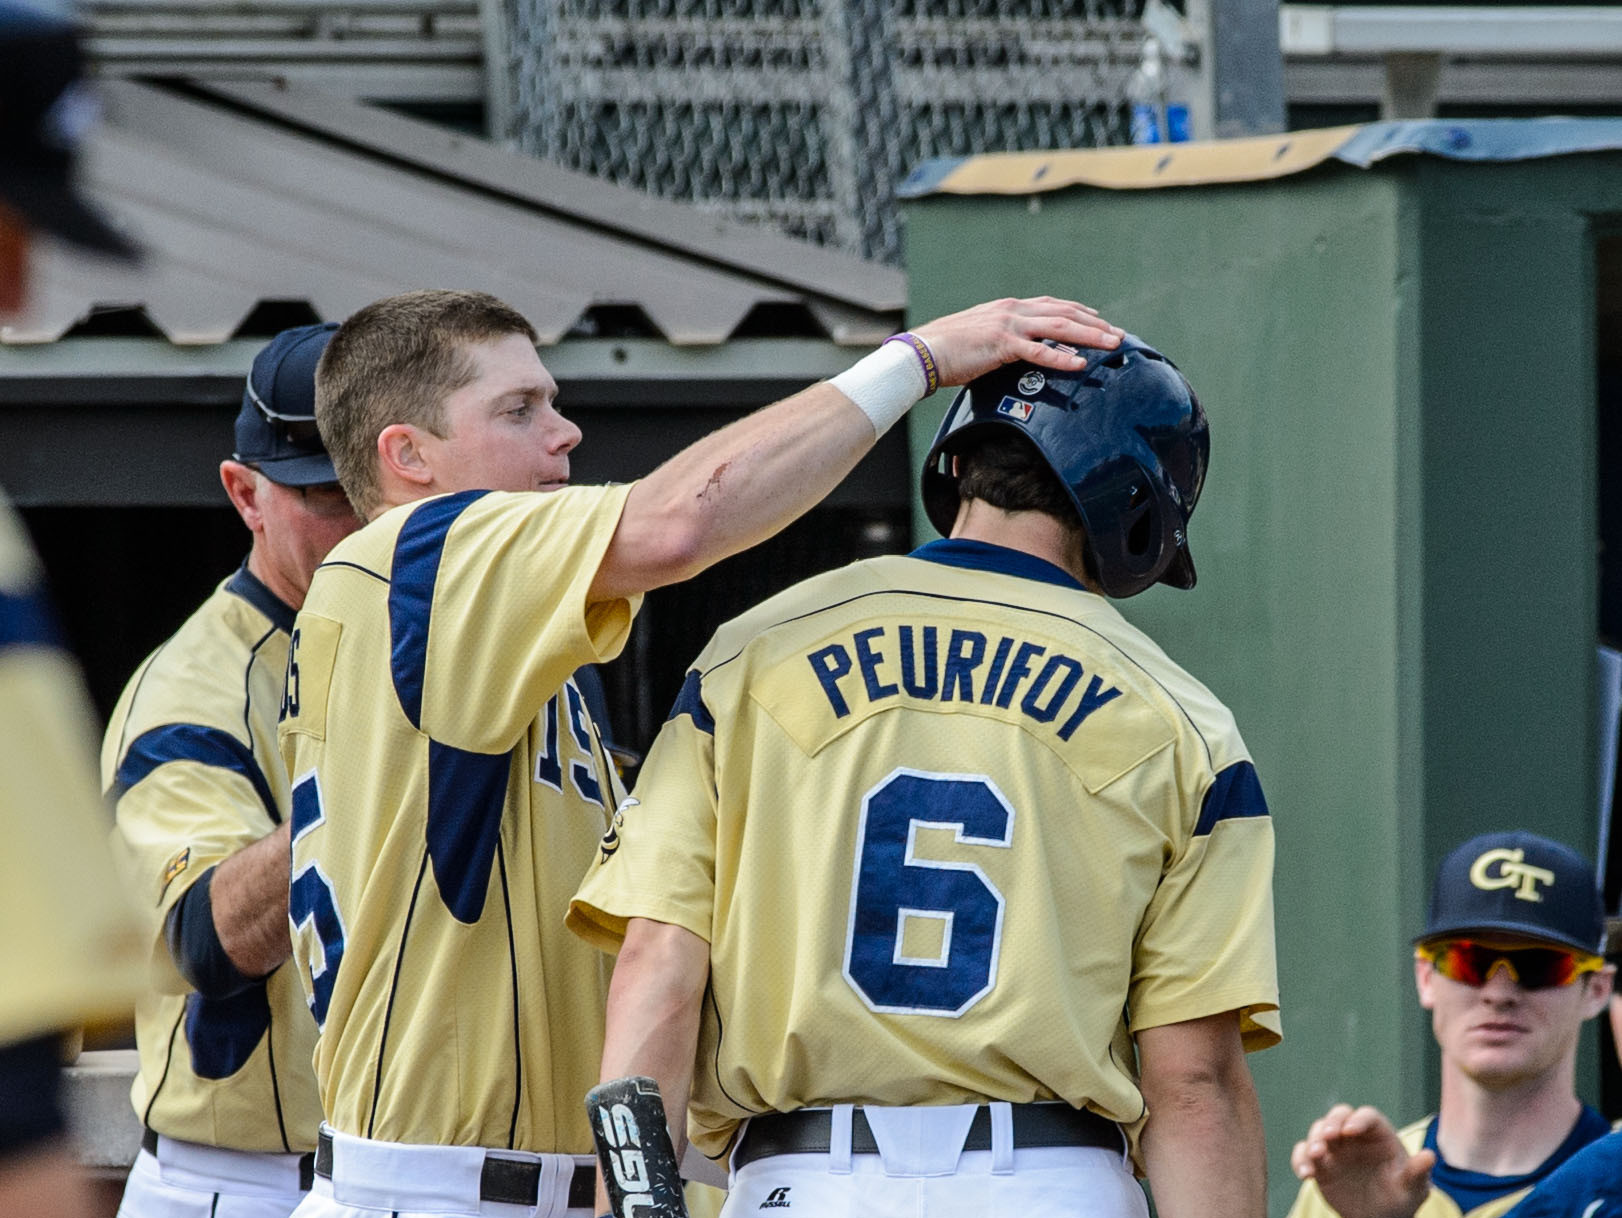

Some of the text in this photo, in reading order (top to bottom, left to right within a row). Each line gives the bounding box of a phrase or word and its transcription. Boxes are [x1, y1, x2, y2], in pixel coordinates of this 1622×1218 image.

[807, 625, 1123, 742] PEURIFOY
[841, 766, 1016, 1019] 6
[1469, 848, 1555, 902] GT
